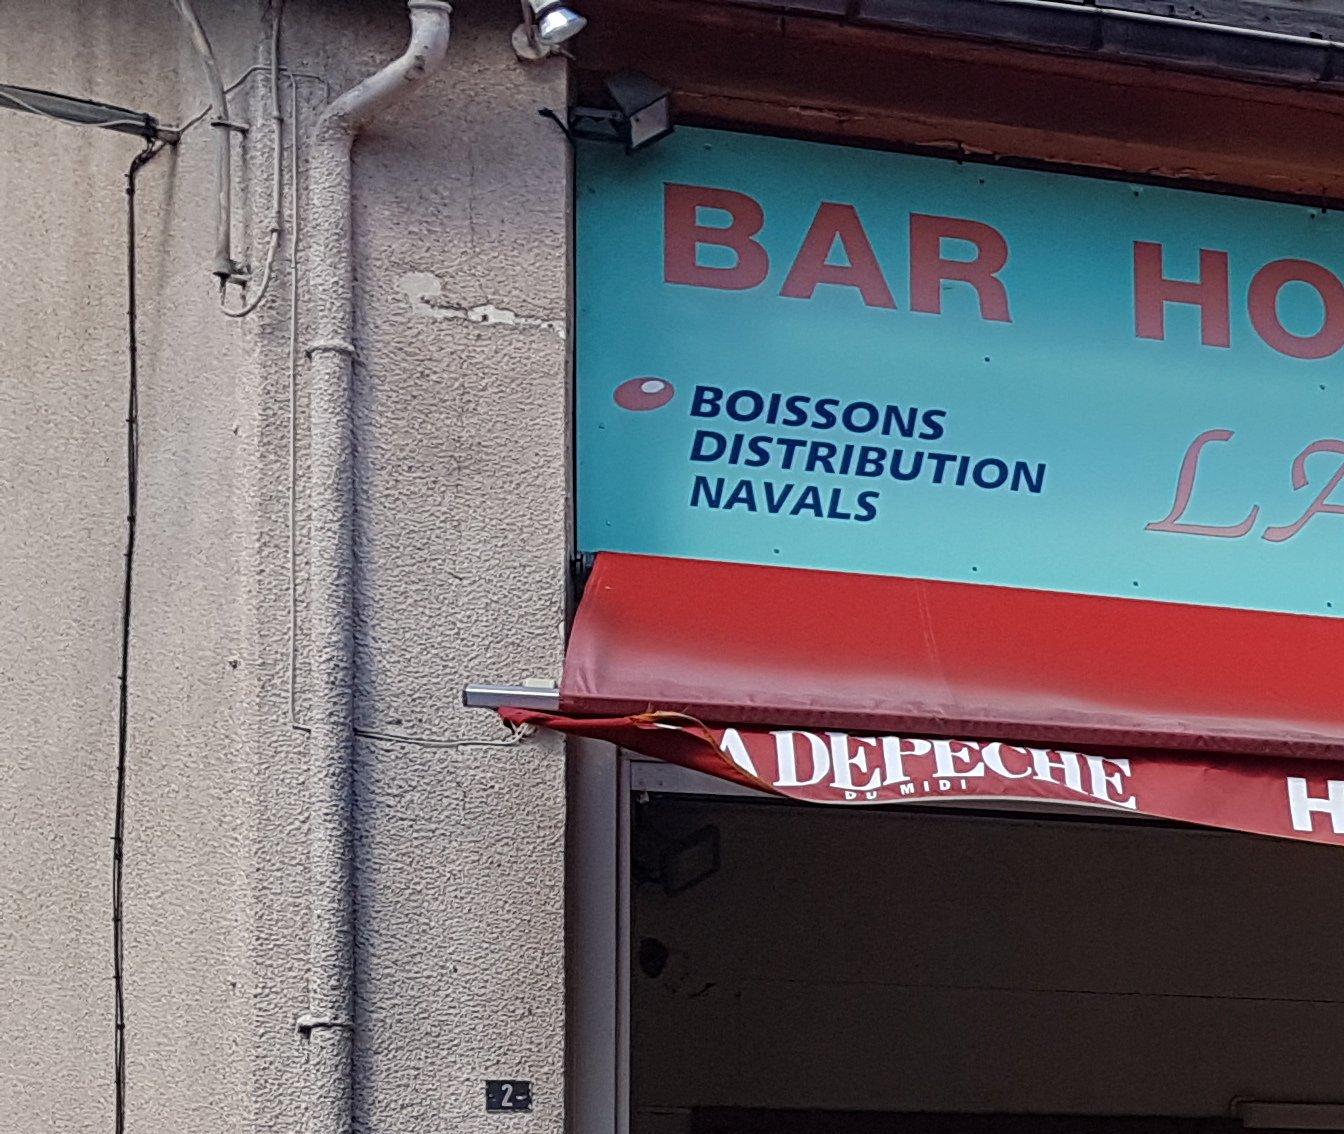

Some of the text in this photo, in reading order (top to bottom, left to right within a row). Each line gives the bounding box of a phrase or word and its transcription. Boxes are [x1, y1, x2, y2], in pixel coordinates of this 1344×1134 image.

[663, 182, 1013, 323] BAR
[689, 385, 947, 440] BOISSONS
[689, 430, 1047, 493] DISTRIBUTION
[689, 475, 880, 522] NAVALS
[845, 779, 967, 799] DU MIDI
[501, 1083, 513, 1107] 2
